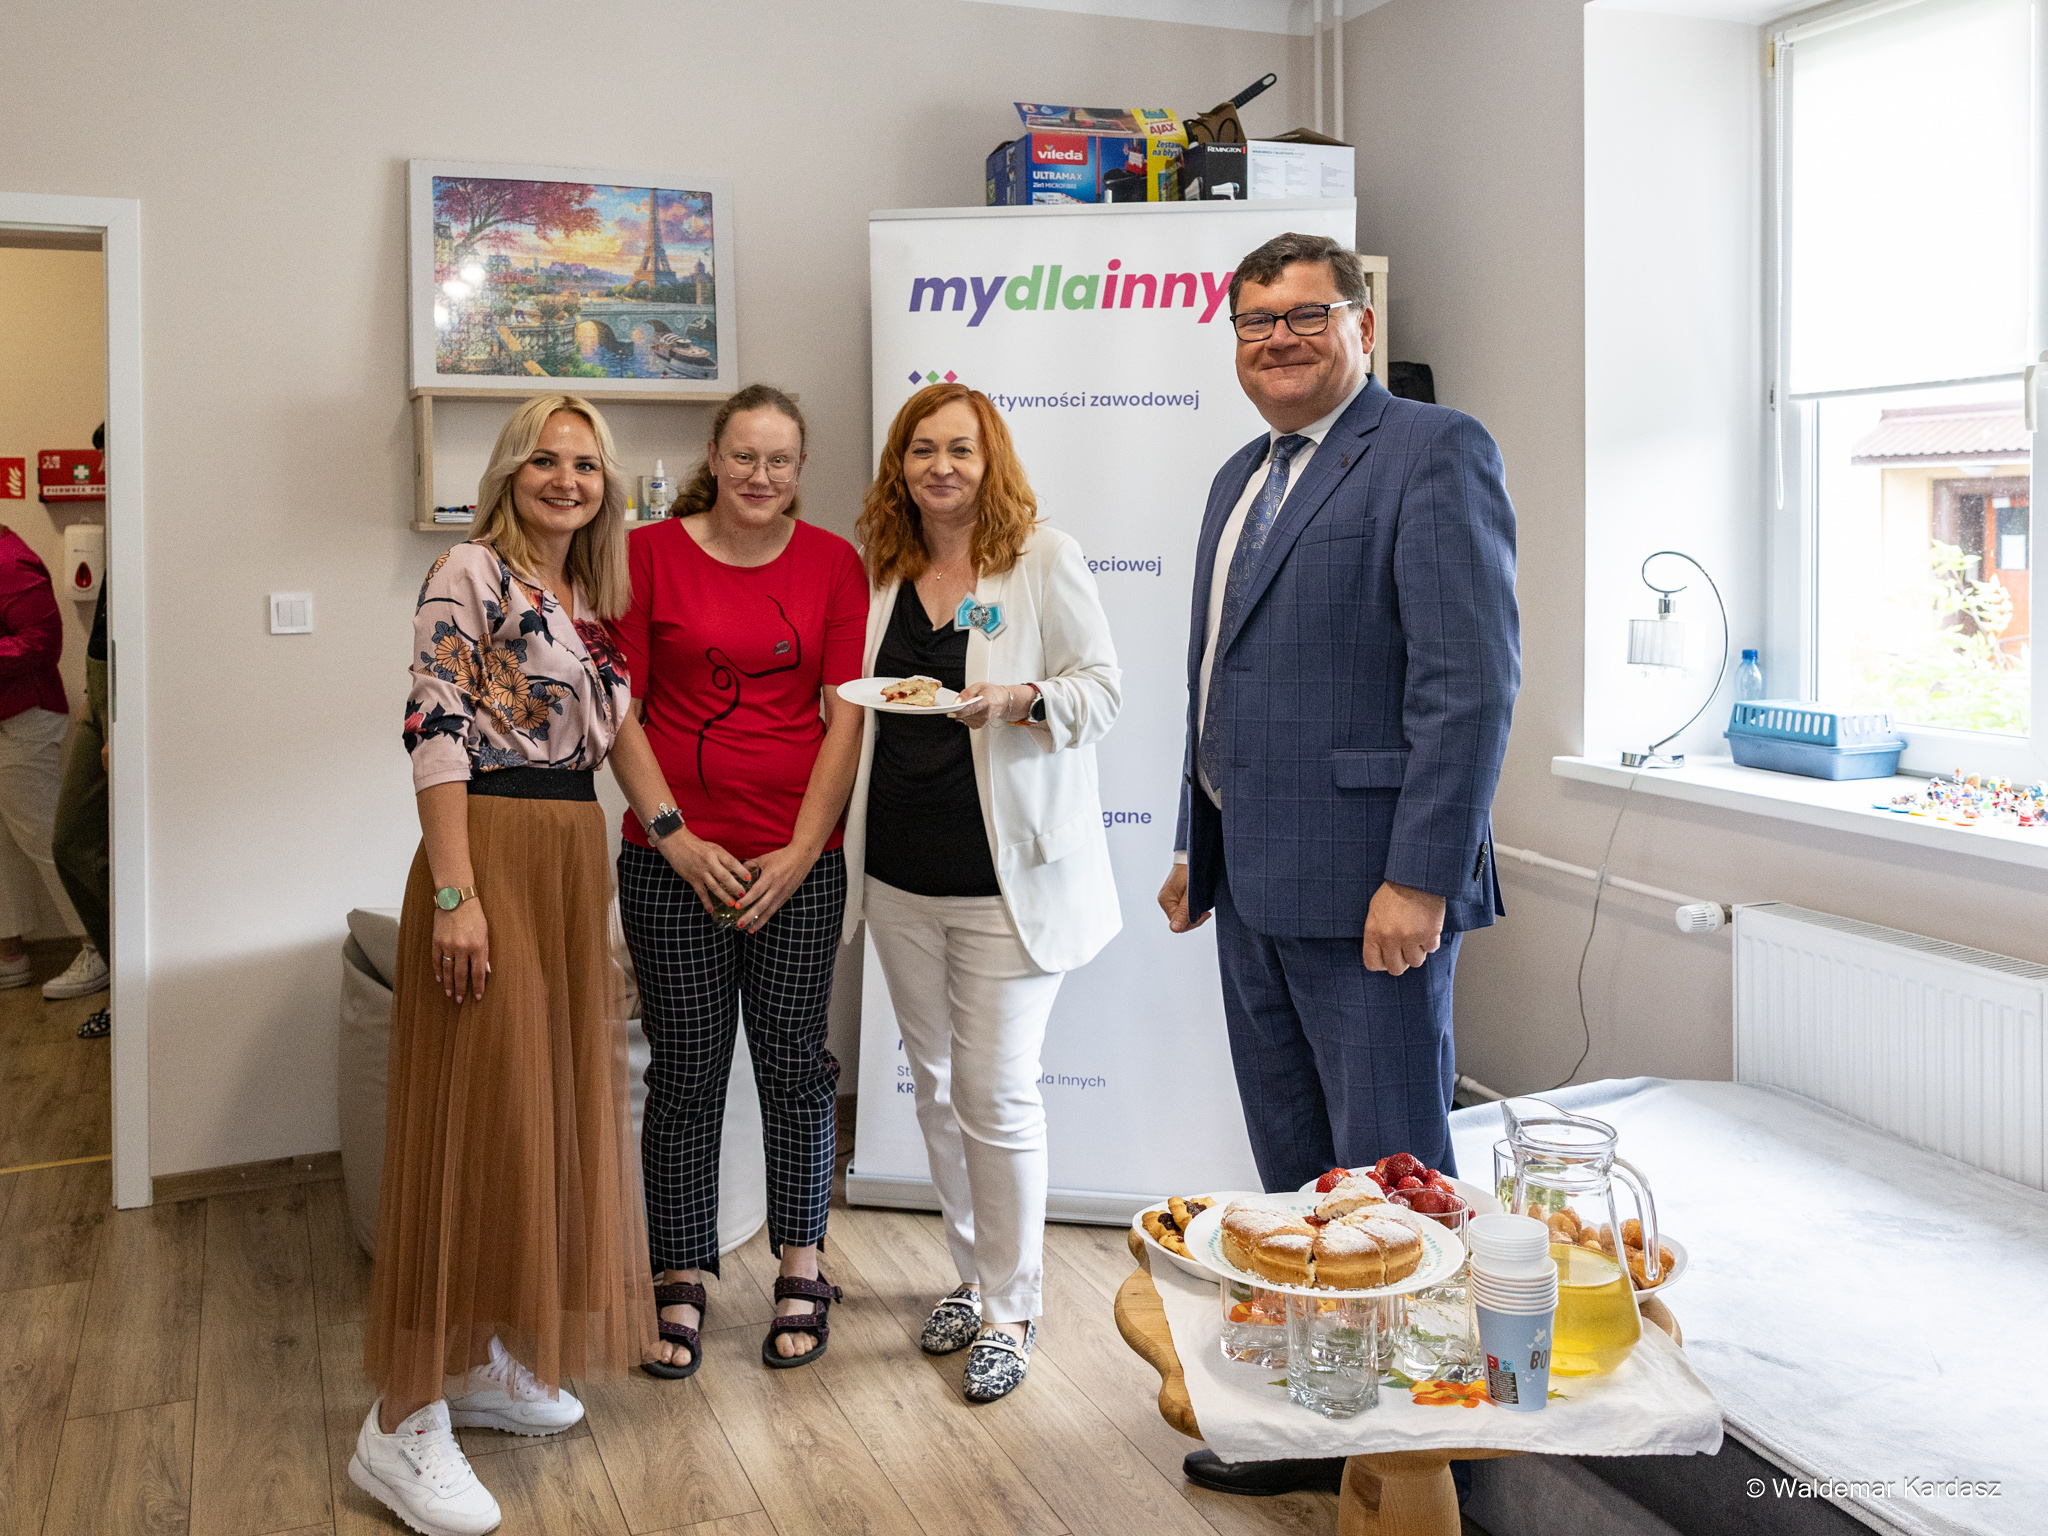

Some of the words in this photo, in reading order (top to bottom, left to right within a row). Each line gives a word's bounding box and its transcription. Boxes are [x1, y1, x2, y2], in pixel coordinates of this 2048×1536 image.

[1149, 123, 1177, 135] AJAX
[1037, 146, 1084, 160] vileda
[1207, 146, 1242, 154] REMINGTON
[1032, 171, 1083, 181] ULTRAMAX
[909, 259, 1236, 327] mydlainny
[988, 391, 1086, 412] ktywności
[1090, 390, 1200, 411] zawodowej
[1083, 556, 1162, 577] ęciowej
[1102, 811, 1152, 828] gane
[897, 1065, 912, 1077] St
[1036, 1072, 1054, 1085] la
[1058, 1073, 1106, 1090] Innych
[897, 1082, 915, 1094] KR
[1530, 1349, 1550, 1370] BO
